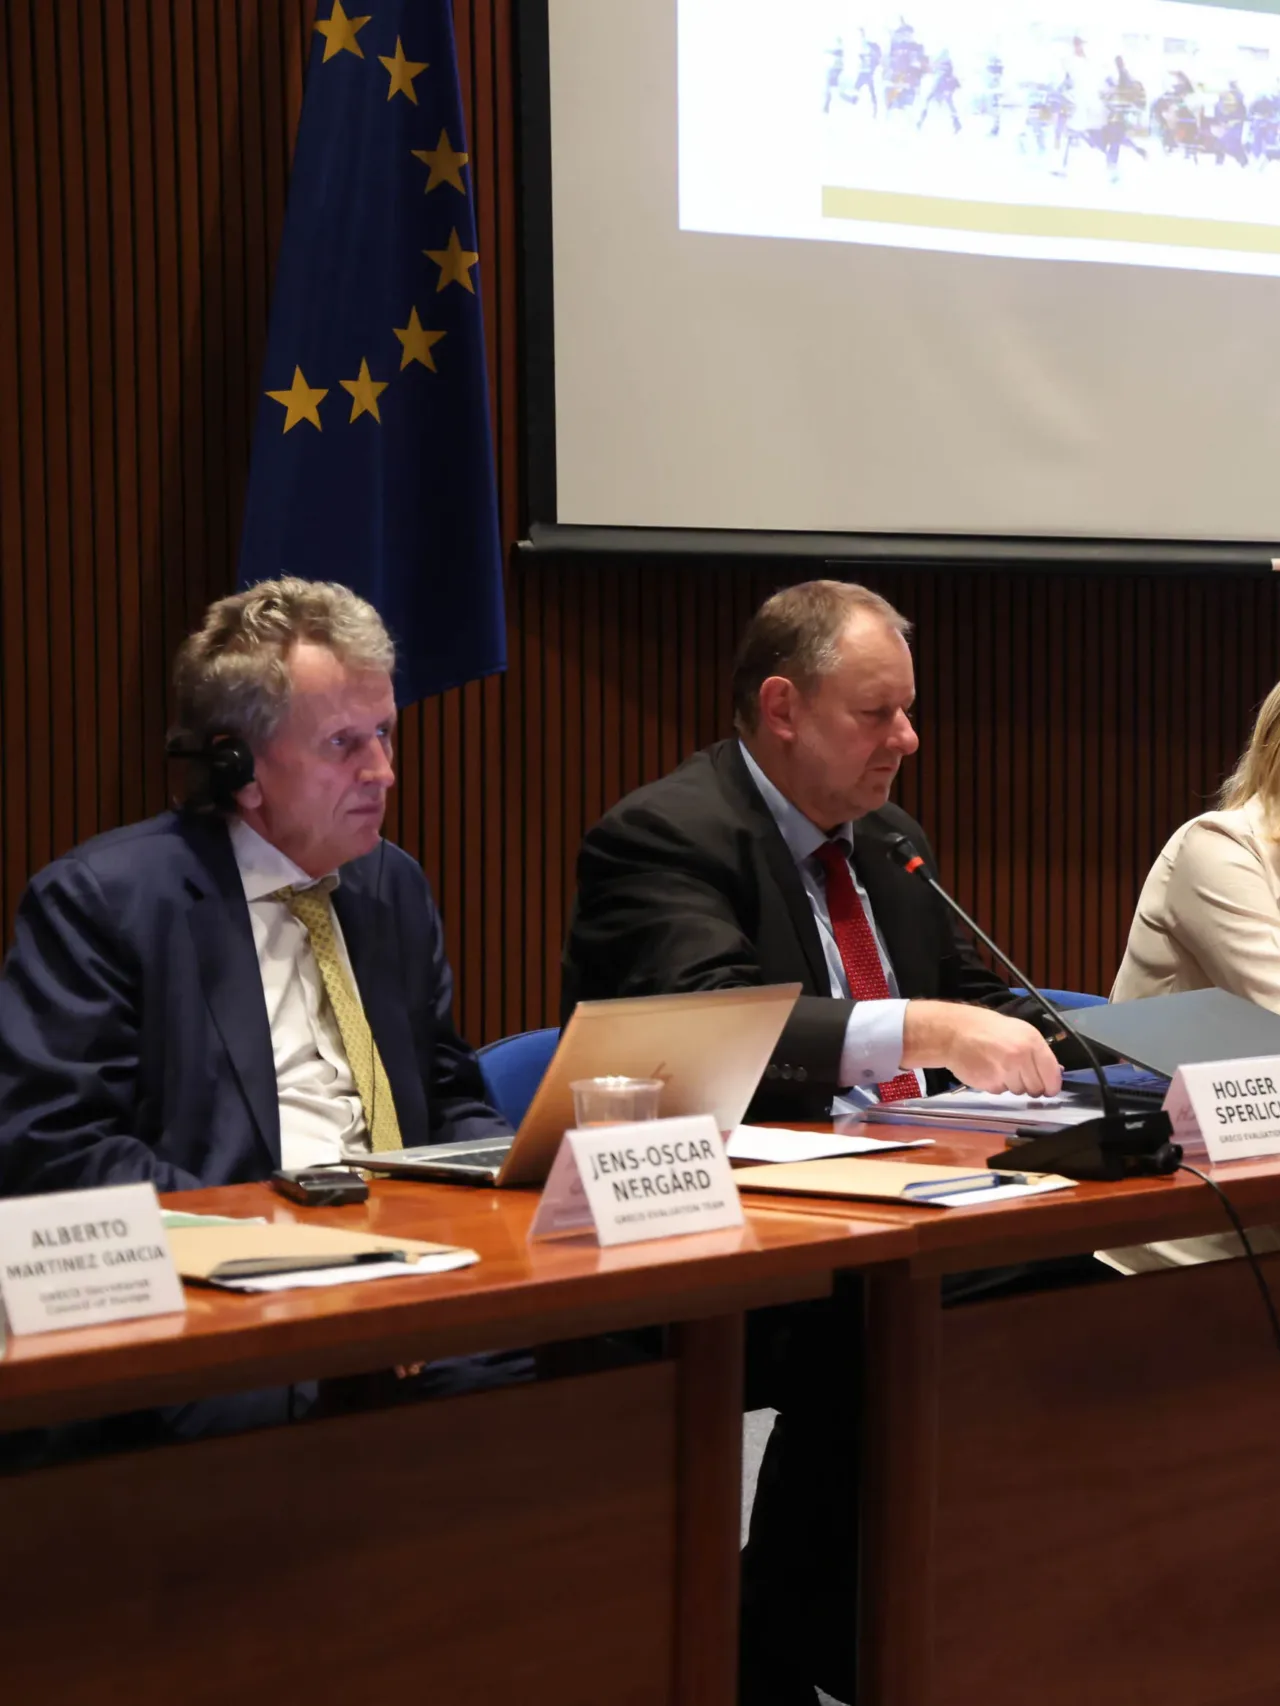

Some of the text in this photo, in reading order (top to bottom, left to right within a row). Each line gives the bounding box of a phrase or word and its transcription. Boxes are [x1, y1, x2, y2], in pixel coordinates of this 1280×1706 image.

[1212, 1077, 1277, 1099] HOLGER
[590, 1139, 715, 1180] JENS-OSCAR
[31, 1219, 129, 1249] ALBERTO
[6, 1252, 99, 1280] MARTINEZ
